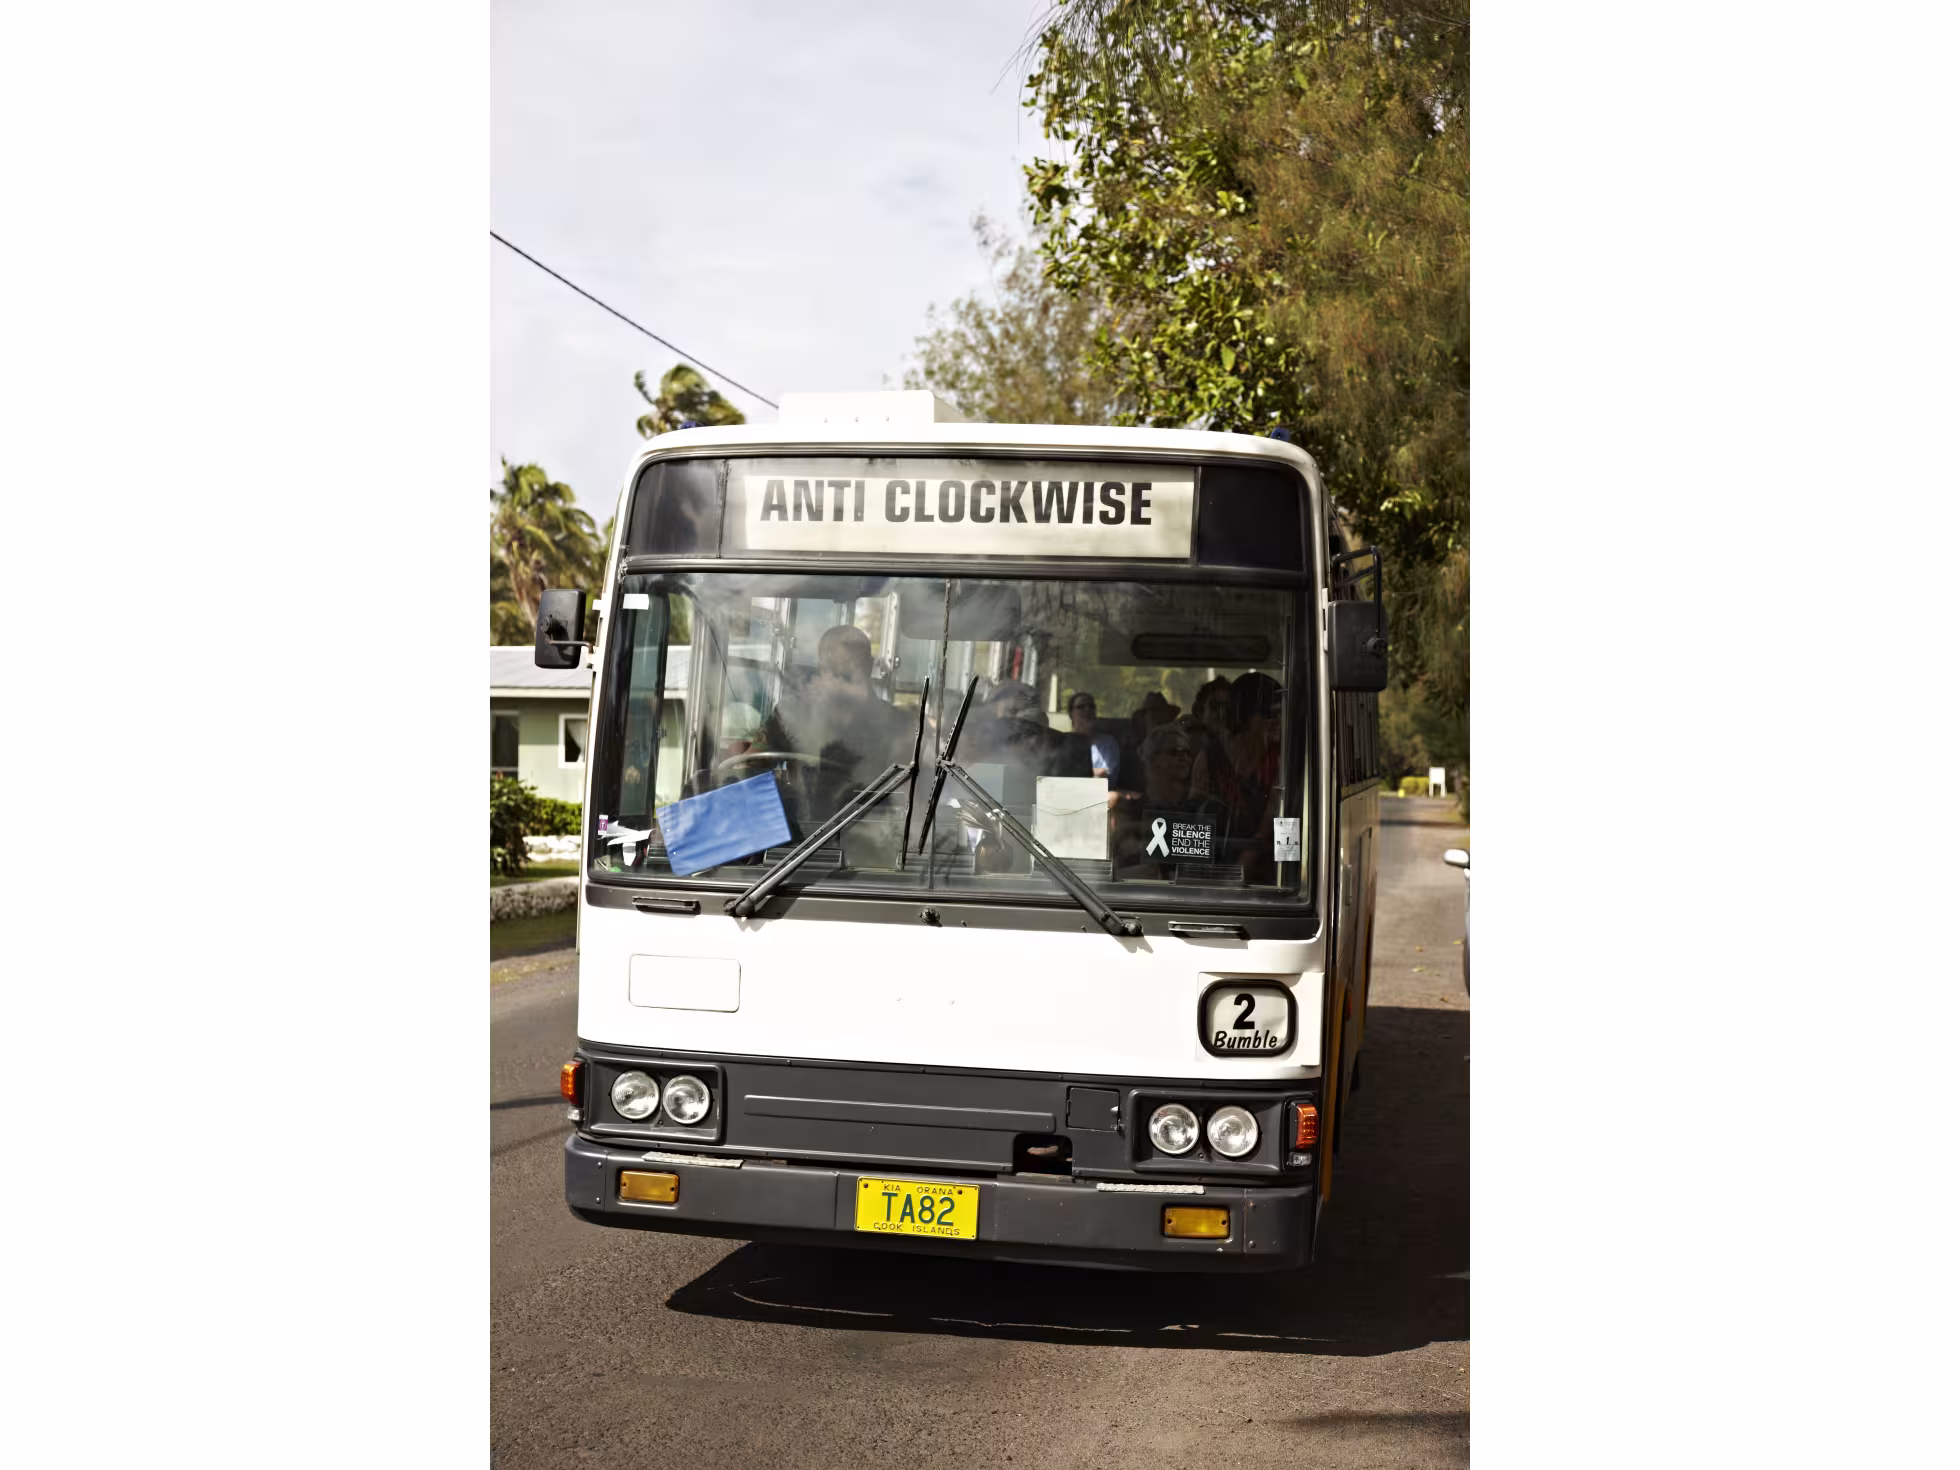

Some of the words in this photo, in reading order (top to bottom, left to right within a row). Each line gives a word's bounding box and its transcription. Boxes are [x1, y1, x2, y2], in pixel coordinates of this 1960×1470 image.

[761, 479, 865, 522] ANTI
[885, 480, 1152, 525] CLOCKWISE
[1172, 823, 1196, 831] BREAK
[1197, 824, 1211, 832] THE
[1172, 829, 1211, 839] SILENCE
[1171, 838, 1191, 847] END
[1192, 839, 1211, 849] THE
[1171, 846, 1210, 856] VIOLENCE
[1232, 993, 1256, 1030] 2
[1213, 1029, 1278, 1049] Bumble
[883, 1184, 901, 1192] KIA
[916, 1186, 954, 1196] ORANA
[881, 1191, 955, 1226] TA82
[873, 1222, 903, 1231] COOK
[912, 1225, 960, 1236] ISLANDS
